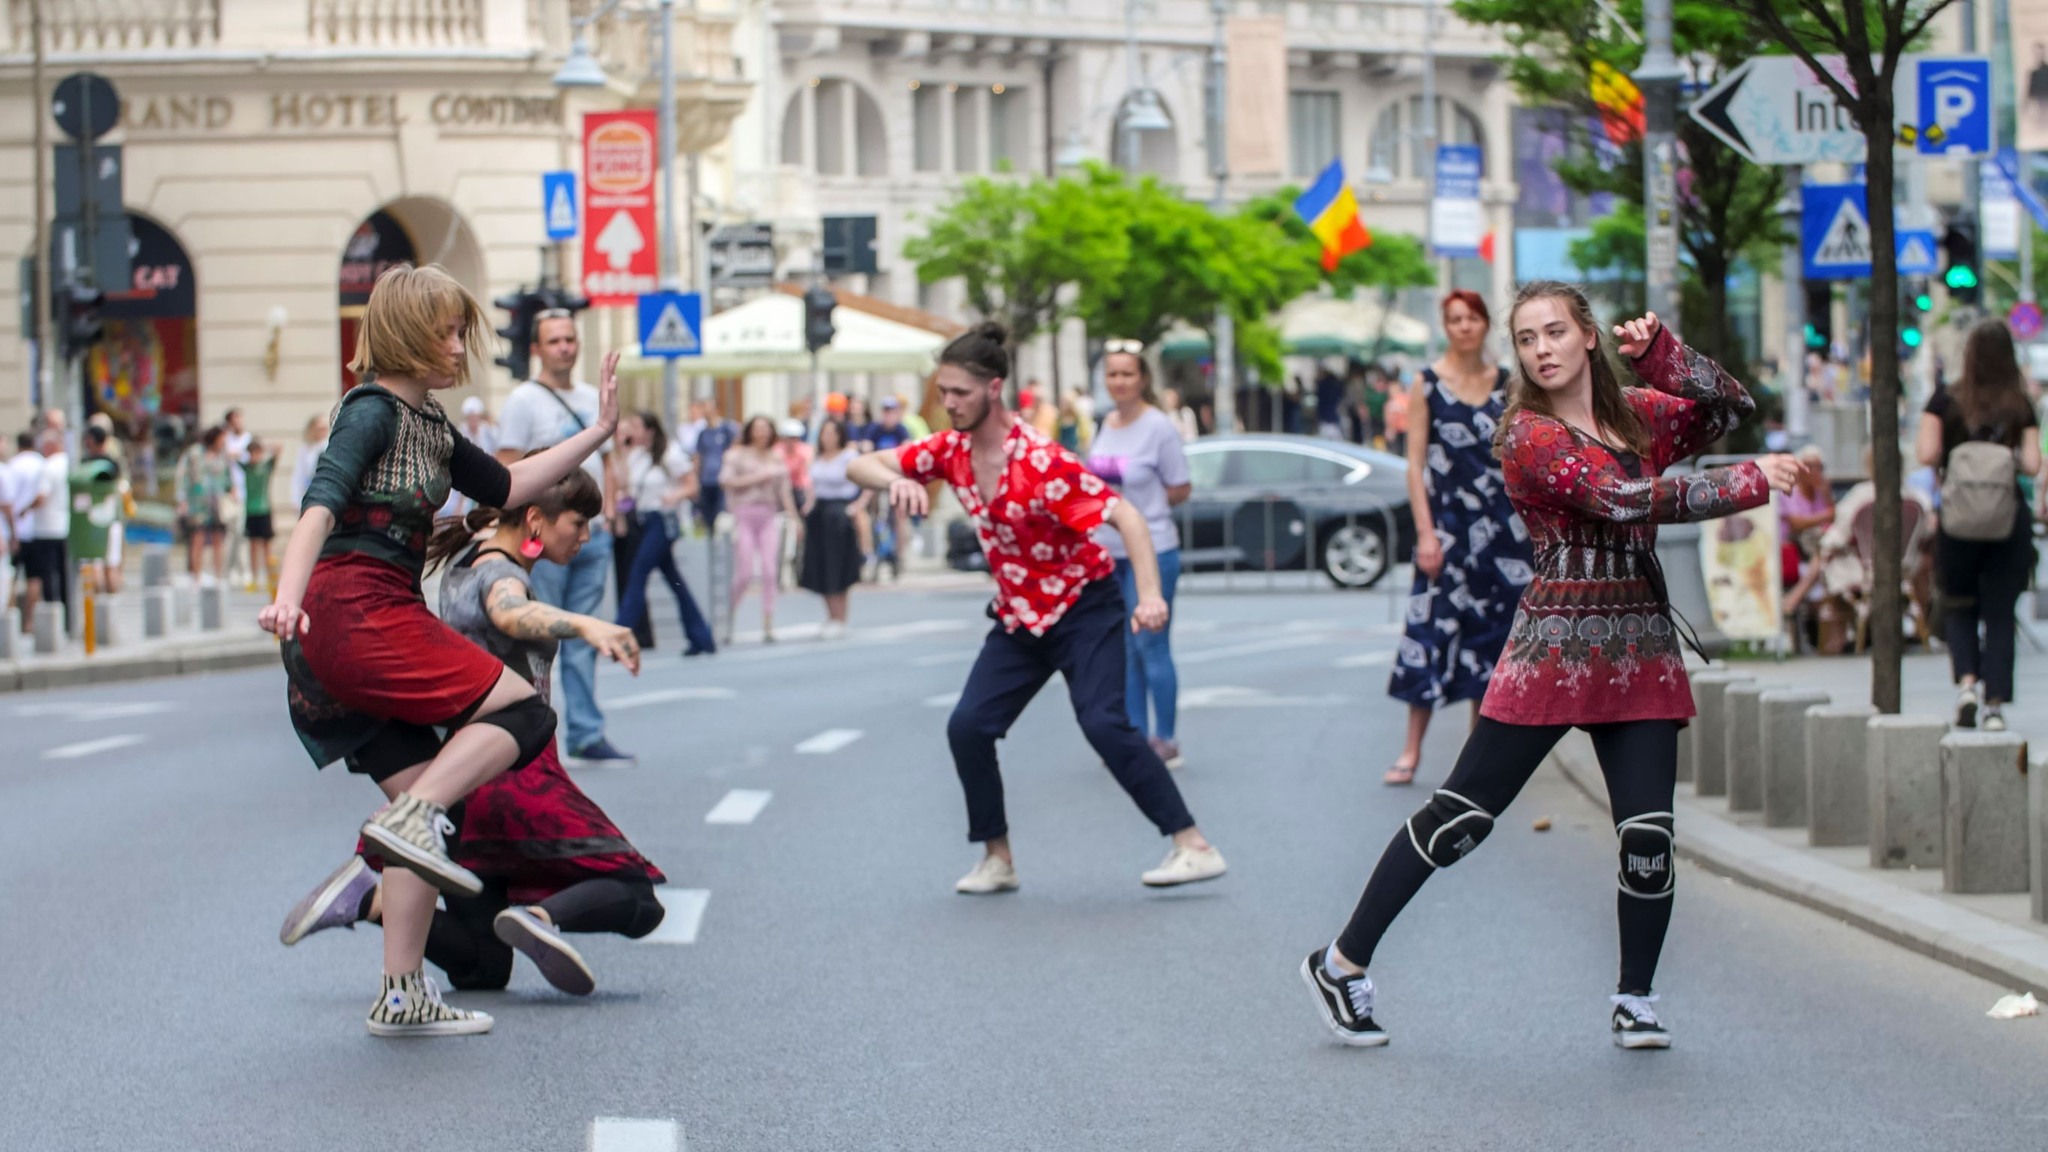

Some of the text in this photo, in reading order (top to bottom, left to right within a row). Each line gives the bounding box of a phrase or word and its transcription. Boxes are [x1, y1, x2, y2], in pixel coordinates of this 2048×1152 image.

[271, 95, 408, 127] HOTEL
[1795, 91, 1862, 132] Int
[134, 264, 181, 290] CAT
[1627, 852, 1666, 873] EVERLAST
